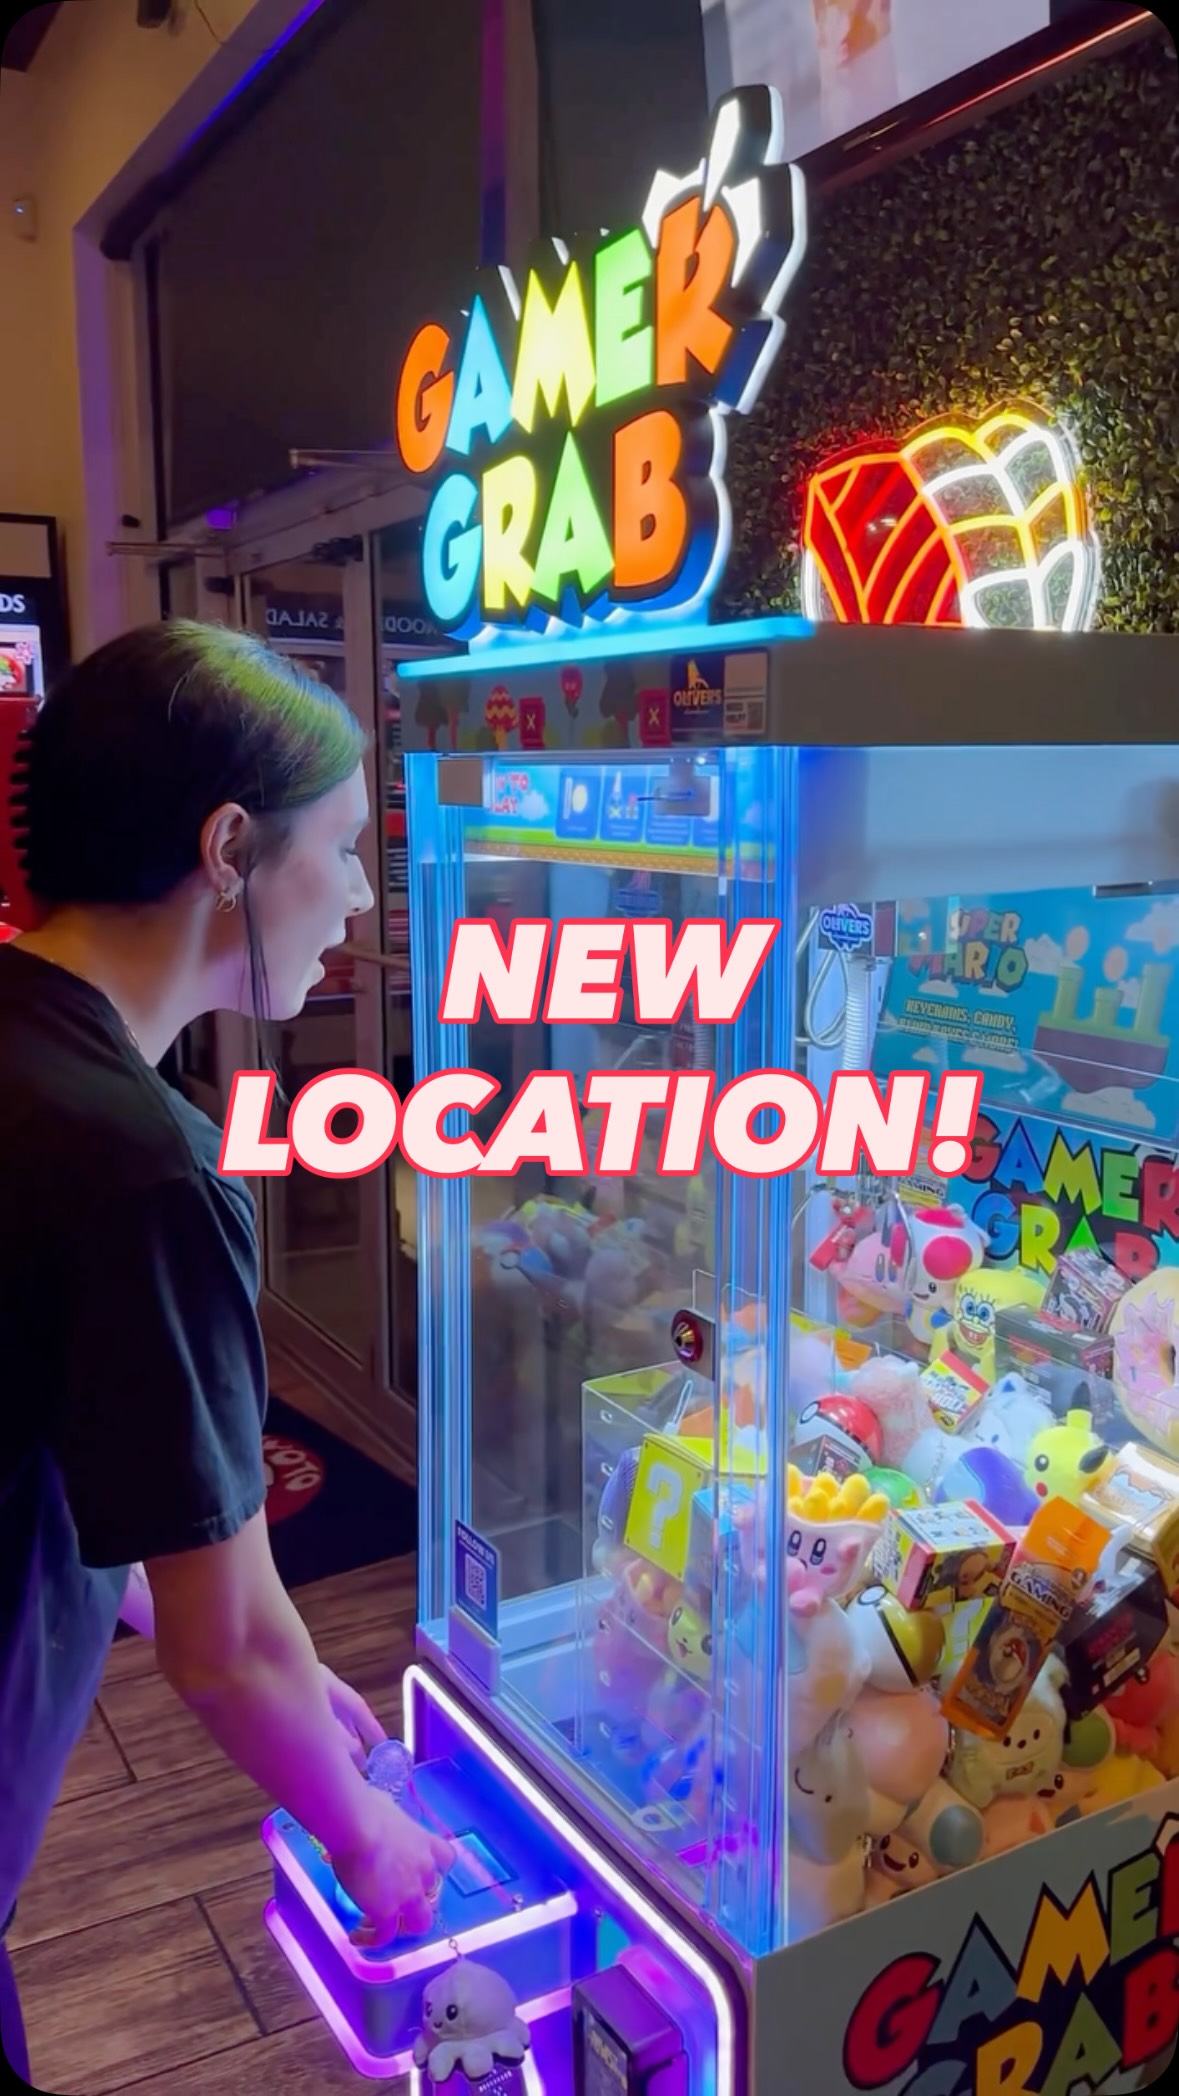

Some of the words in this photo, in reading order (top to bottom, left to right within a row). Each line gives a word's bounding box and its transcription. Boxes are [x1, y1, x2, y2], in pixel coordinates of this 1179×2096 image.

[397, 195, 734, 473] GAMER
[423, 409, 687, 621] GRAB
[909, 938, 1028, 992] MARIO
[950, 907, 1021, 943] SUPER
[961, 1112, 1179, 1238] GAMER
[1010, 1571, 1072, 1619] GAMING
